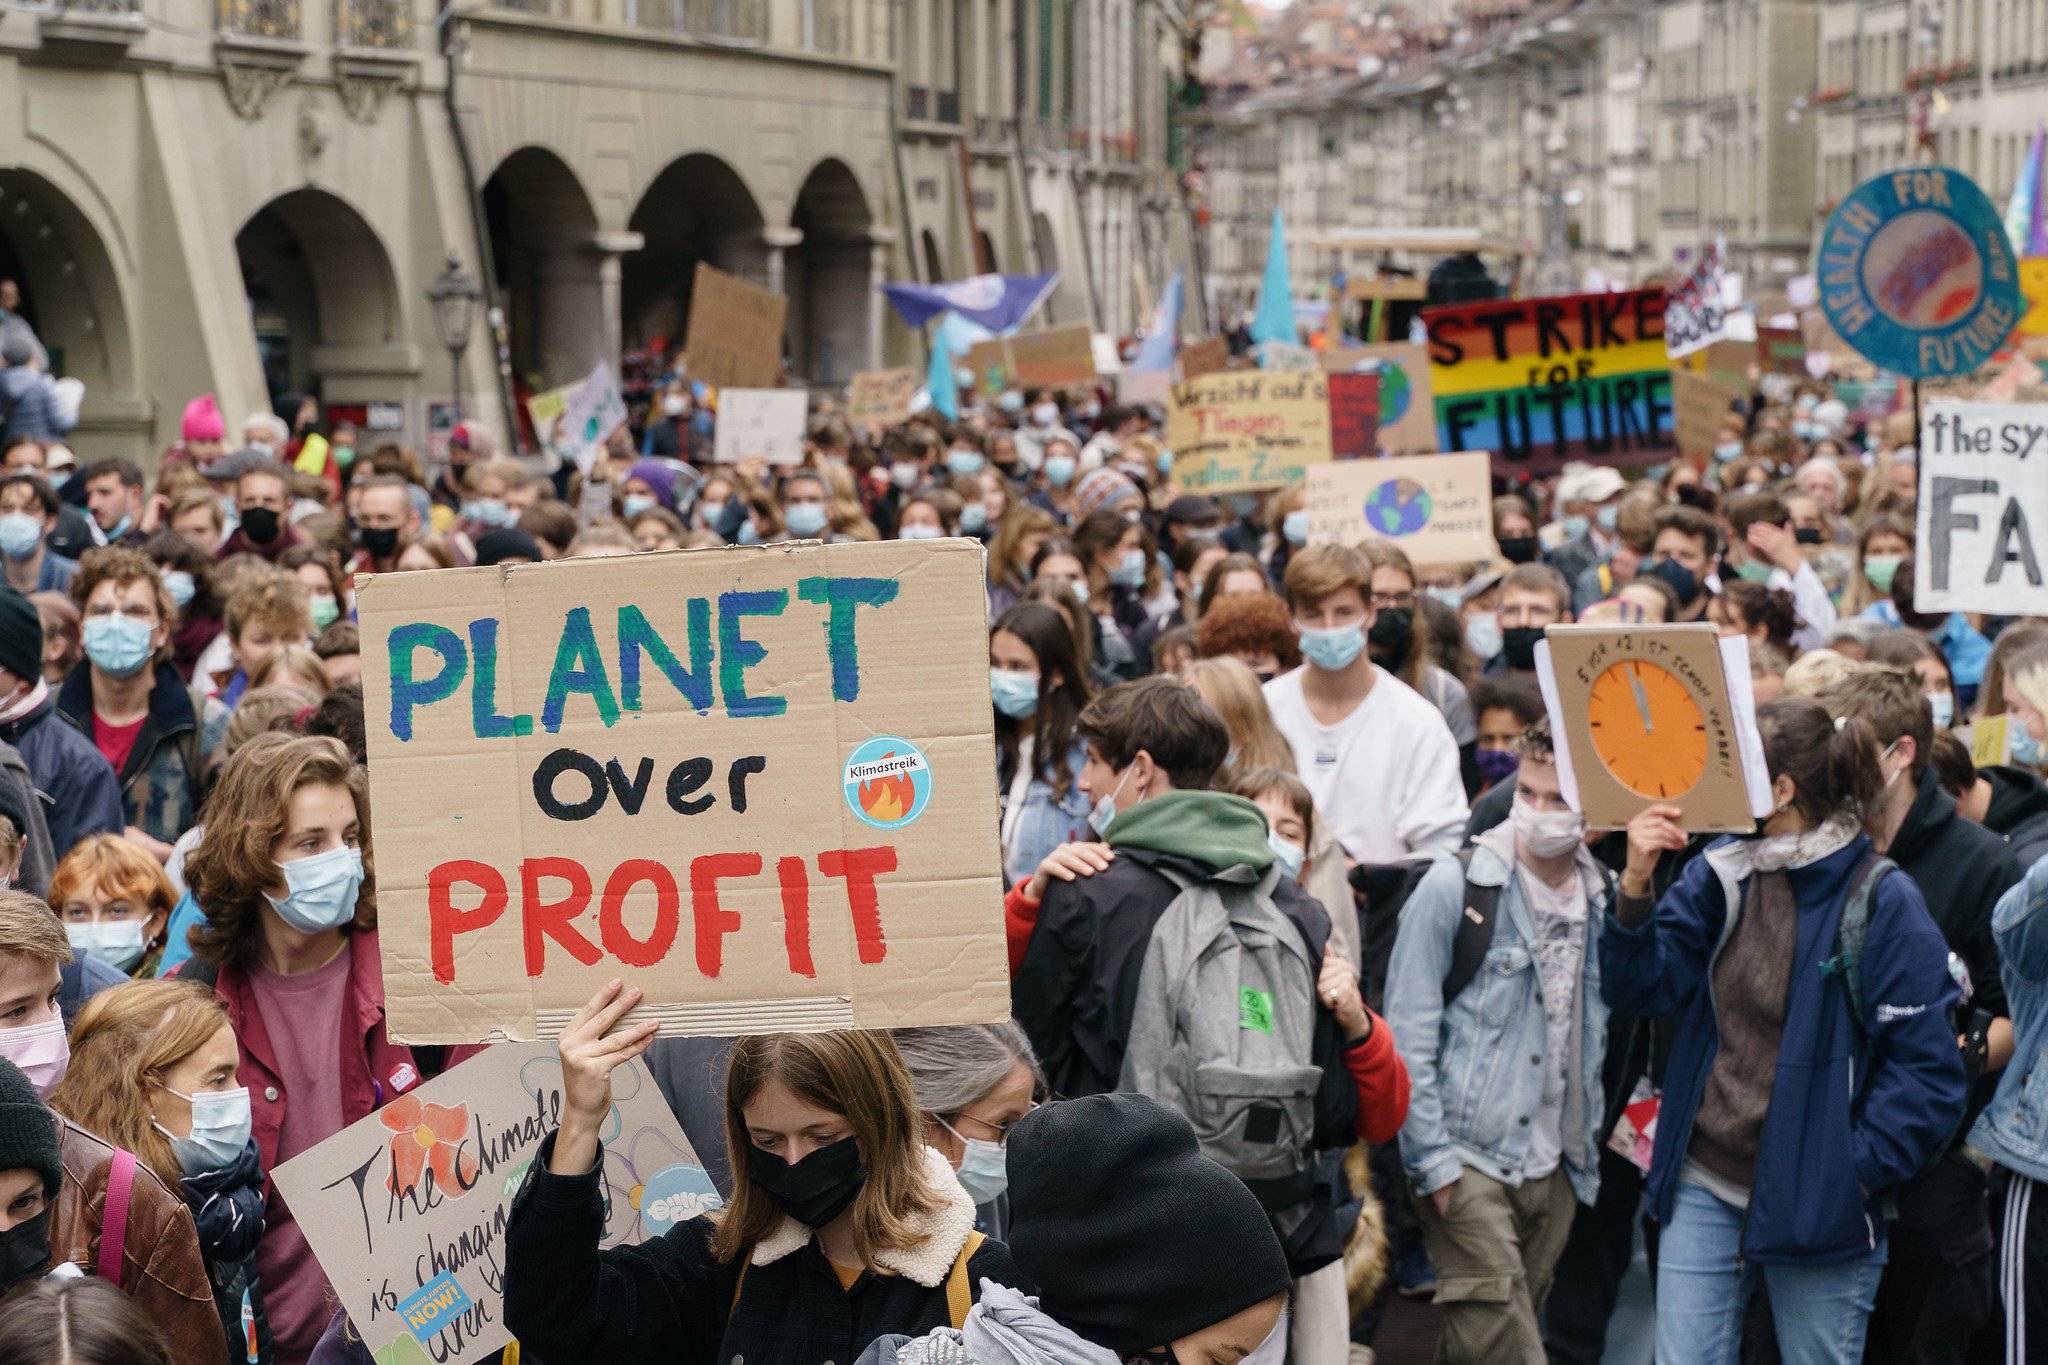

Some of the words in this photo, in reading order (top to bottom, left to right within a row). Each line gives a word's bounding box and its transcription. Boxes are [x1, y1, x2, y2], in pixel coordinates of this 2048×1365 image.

[1825, 201, 1881, 335] HEALTH
[1892, 170, 1953, 208] FOR
[1429, 289, 1665, 367] STRIKE
[1918, 296, 2013, 372] FUTURE
[1527, 359, 1595, 387] FOR
[1445, 372, 1676, 461] FUTURE
[1928, 412, 1993, 454] the
[2001, 423, 2048, 460] sy
[387, 576, 900, 742] PLANET
[1615, 634, 1633, 651] 12
[1640, 639, 1669, 656] IST
[850, 756, 918, 778] Klimastreik
[425, 846, 898, 985] PROFIT
[320, 1144, 444, 1255] The
[366, 1277, 398, 1322] is
[402, 1295, 428, 1316] CLIMATE
[427, 1279, 451, 1298] JUSTICE
[407, 1285, 462, 1331] NOW!
